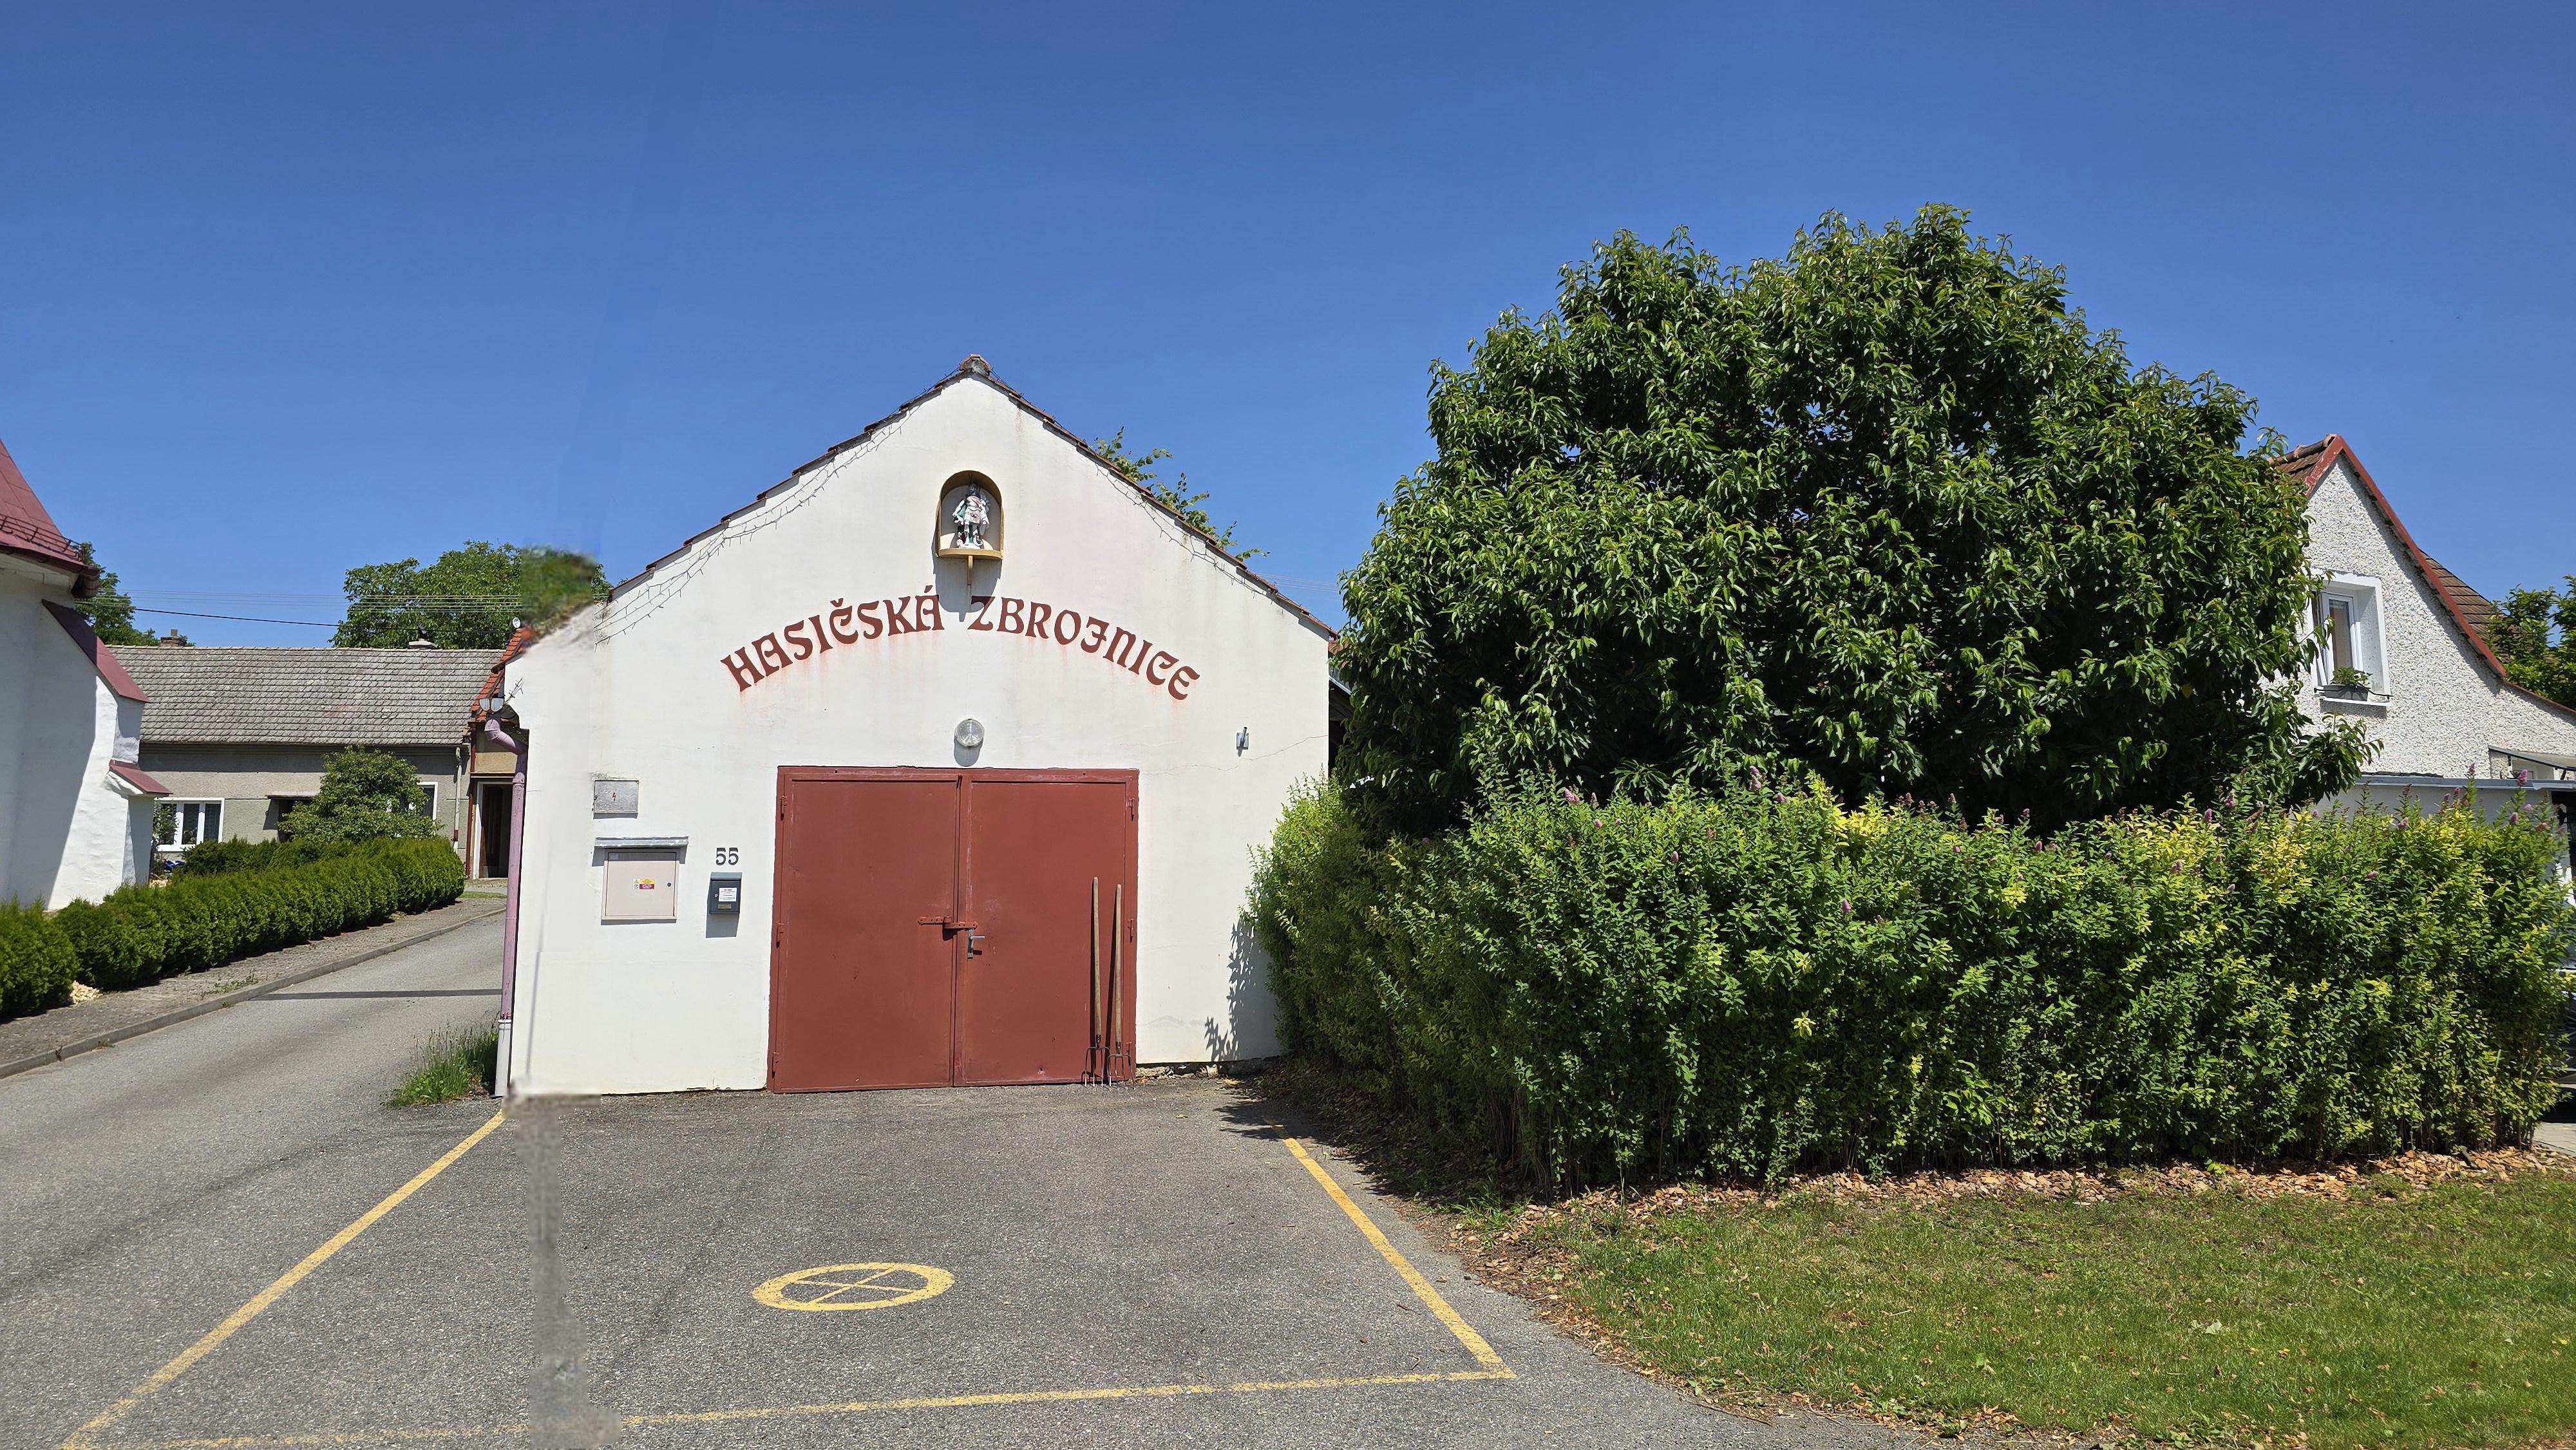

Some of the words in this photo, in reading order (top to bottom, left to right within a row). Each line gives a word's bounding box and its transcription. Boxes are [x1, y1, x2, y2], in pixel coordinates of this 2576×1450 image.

[720, 585, 945, 693] HASIČSKÁ
[967, 595, 1200, 701] ZBROJNICE
[715, 847, 739, 866] 55
